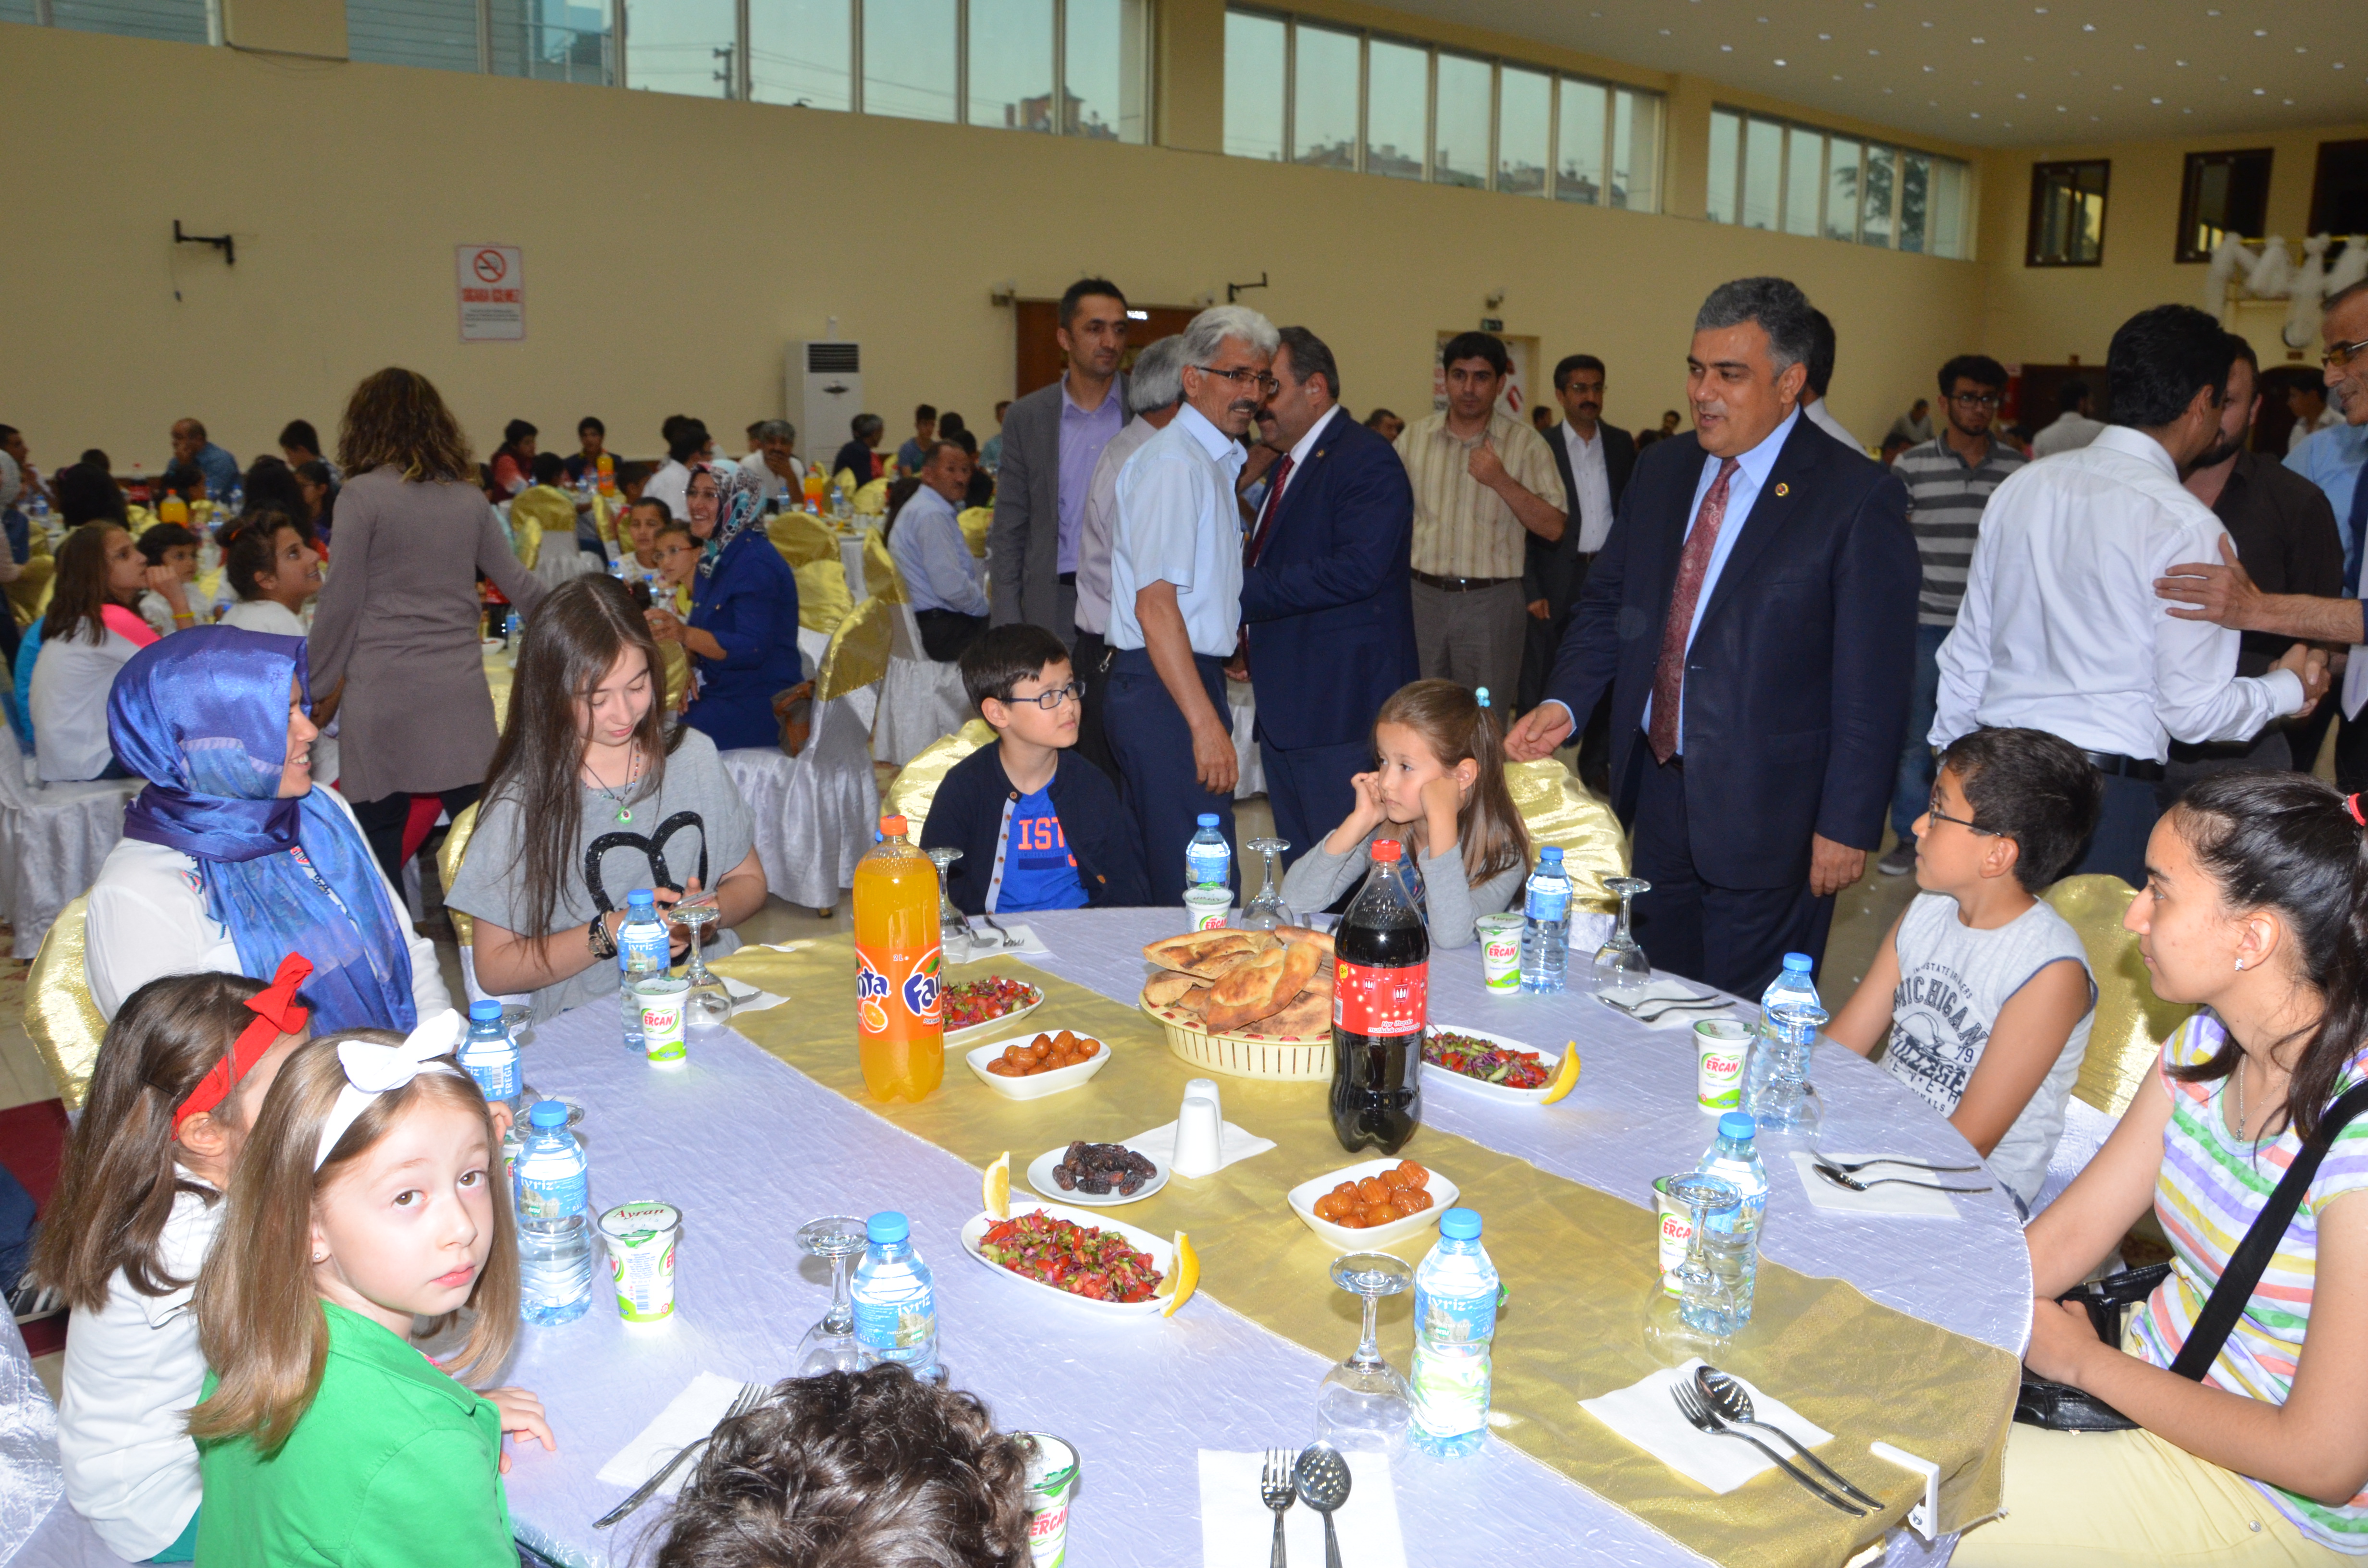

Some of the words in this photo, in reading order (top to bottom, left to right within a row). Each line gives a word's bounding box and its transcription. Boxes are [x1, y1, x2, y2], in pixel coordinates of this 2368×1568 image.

[628, 943, 654, 951] ivriz
[1489, 947, 1516, 957] ERCAN
[857, 966, 889, 1000] nta
[903, 969, 942, 1016] Fan
[1893, 976, 1989, 1047] MICHIGAN
[644, 1015, 673, 1027] ERCAN
[1394, 1018, 1413, 1027] iftarda
[1954, 1046, 1974, 1063] 79
[1706, 1060, 1738, 1072] ERCAN
[520, 1176, 554, 1191] ivriz
[613, 1209, 664, 1220] Ayran
[1663, 1221, 1692, 1239] ERCA
[897, 1295, 931, 1317] ivriz
[1428, 1293, 1467, 1311] ivriz
[910, 1331, 924, 1340] ersu
[1435, 1327, 1450, 1336] ersu
[1030, 1506, 1068, 1536] ERCAN
